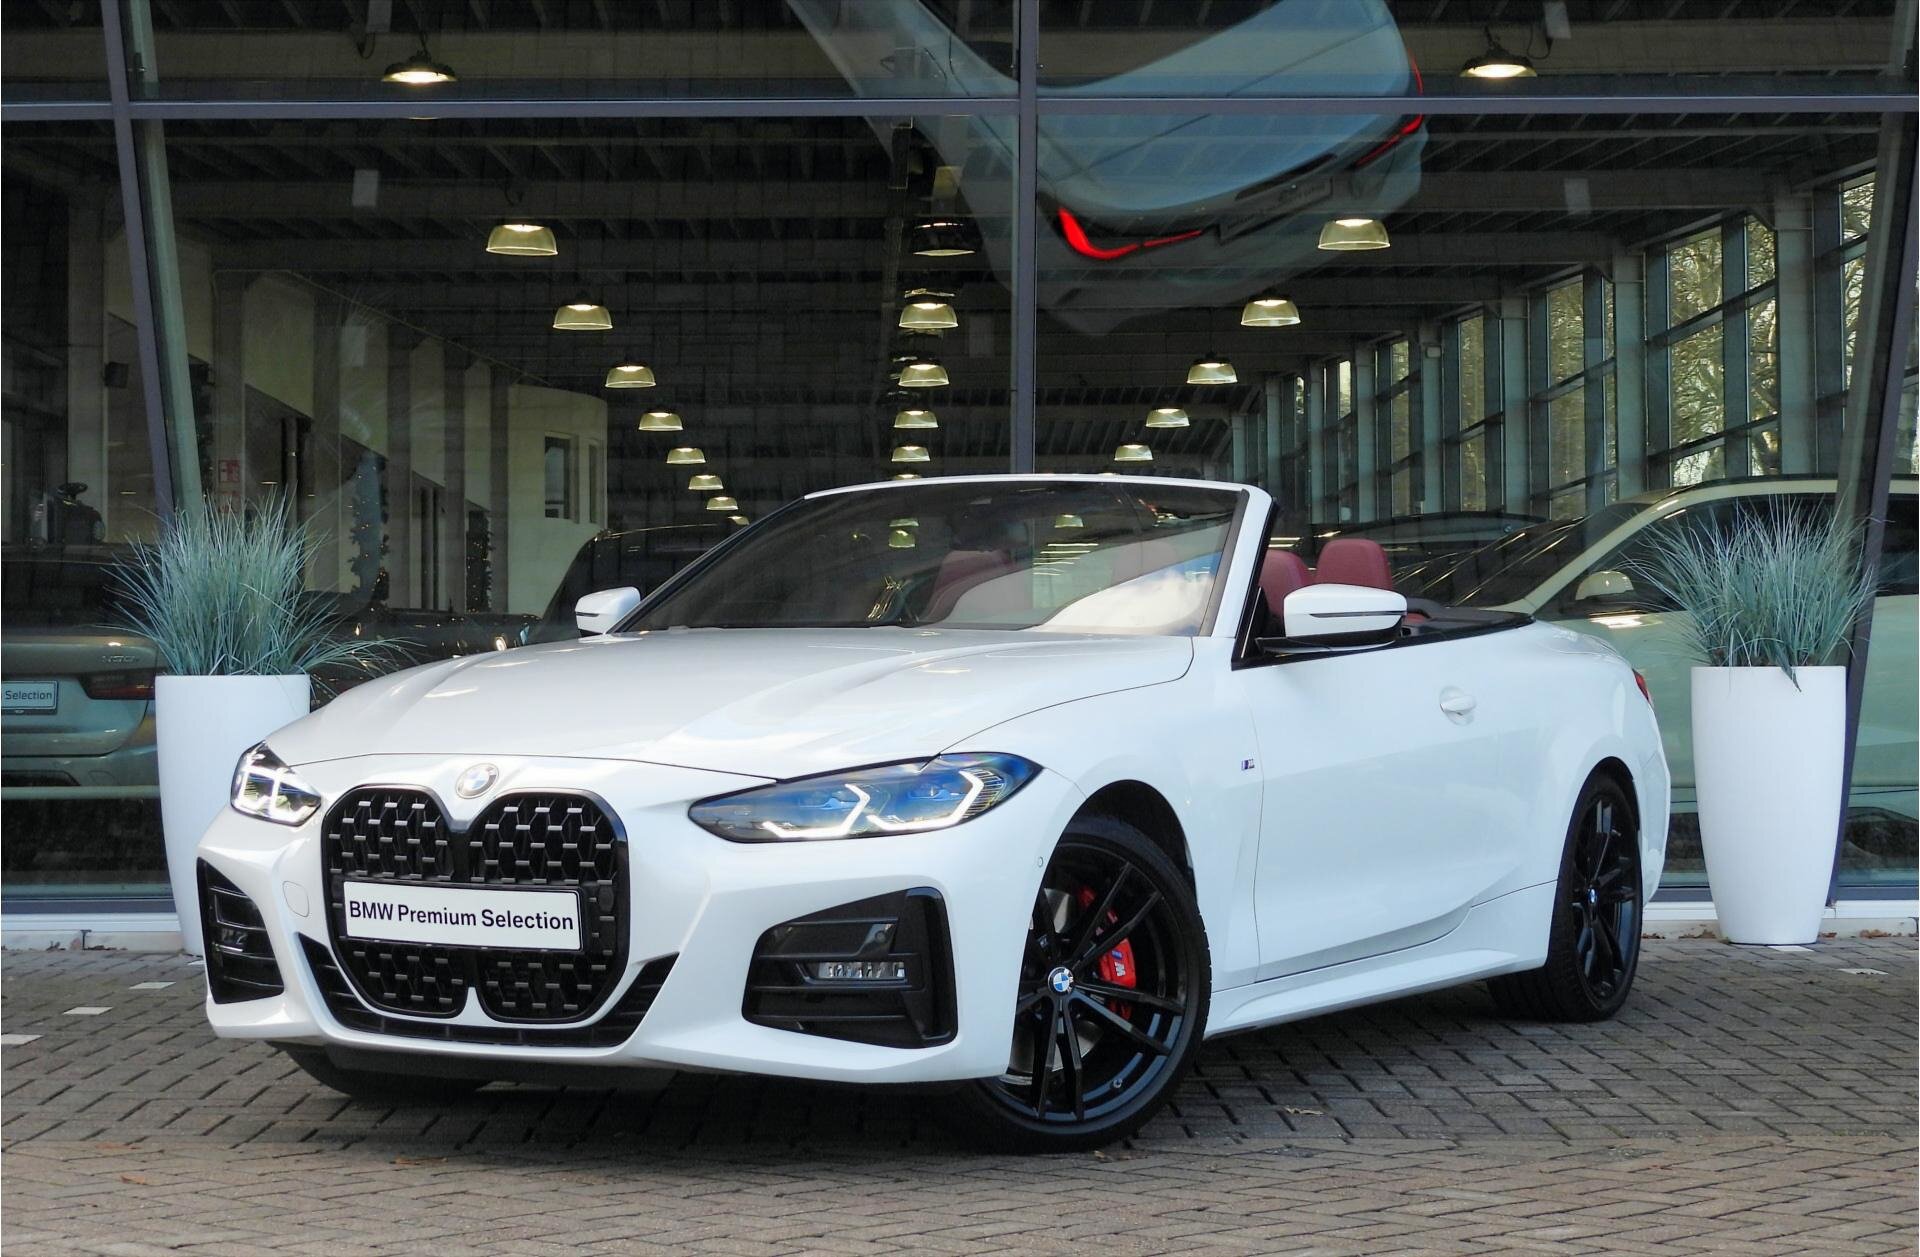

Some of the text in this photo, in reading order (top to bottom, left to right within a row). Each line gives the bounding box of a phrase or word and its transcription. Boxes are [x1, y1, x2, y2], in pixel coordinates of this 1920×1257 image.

[5, 690, 52, 700] Selection
[349, 900, 574, 930] BMW Premium Selection
